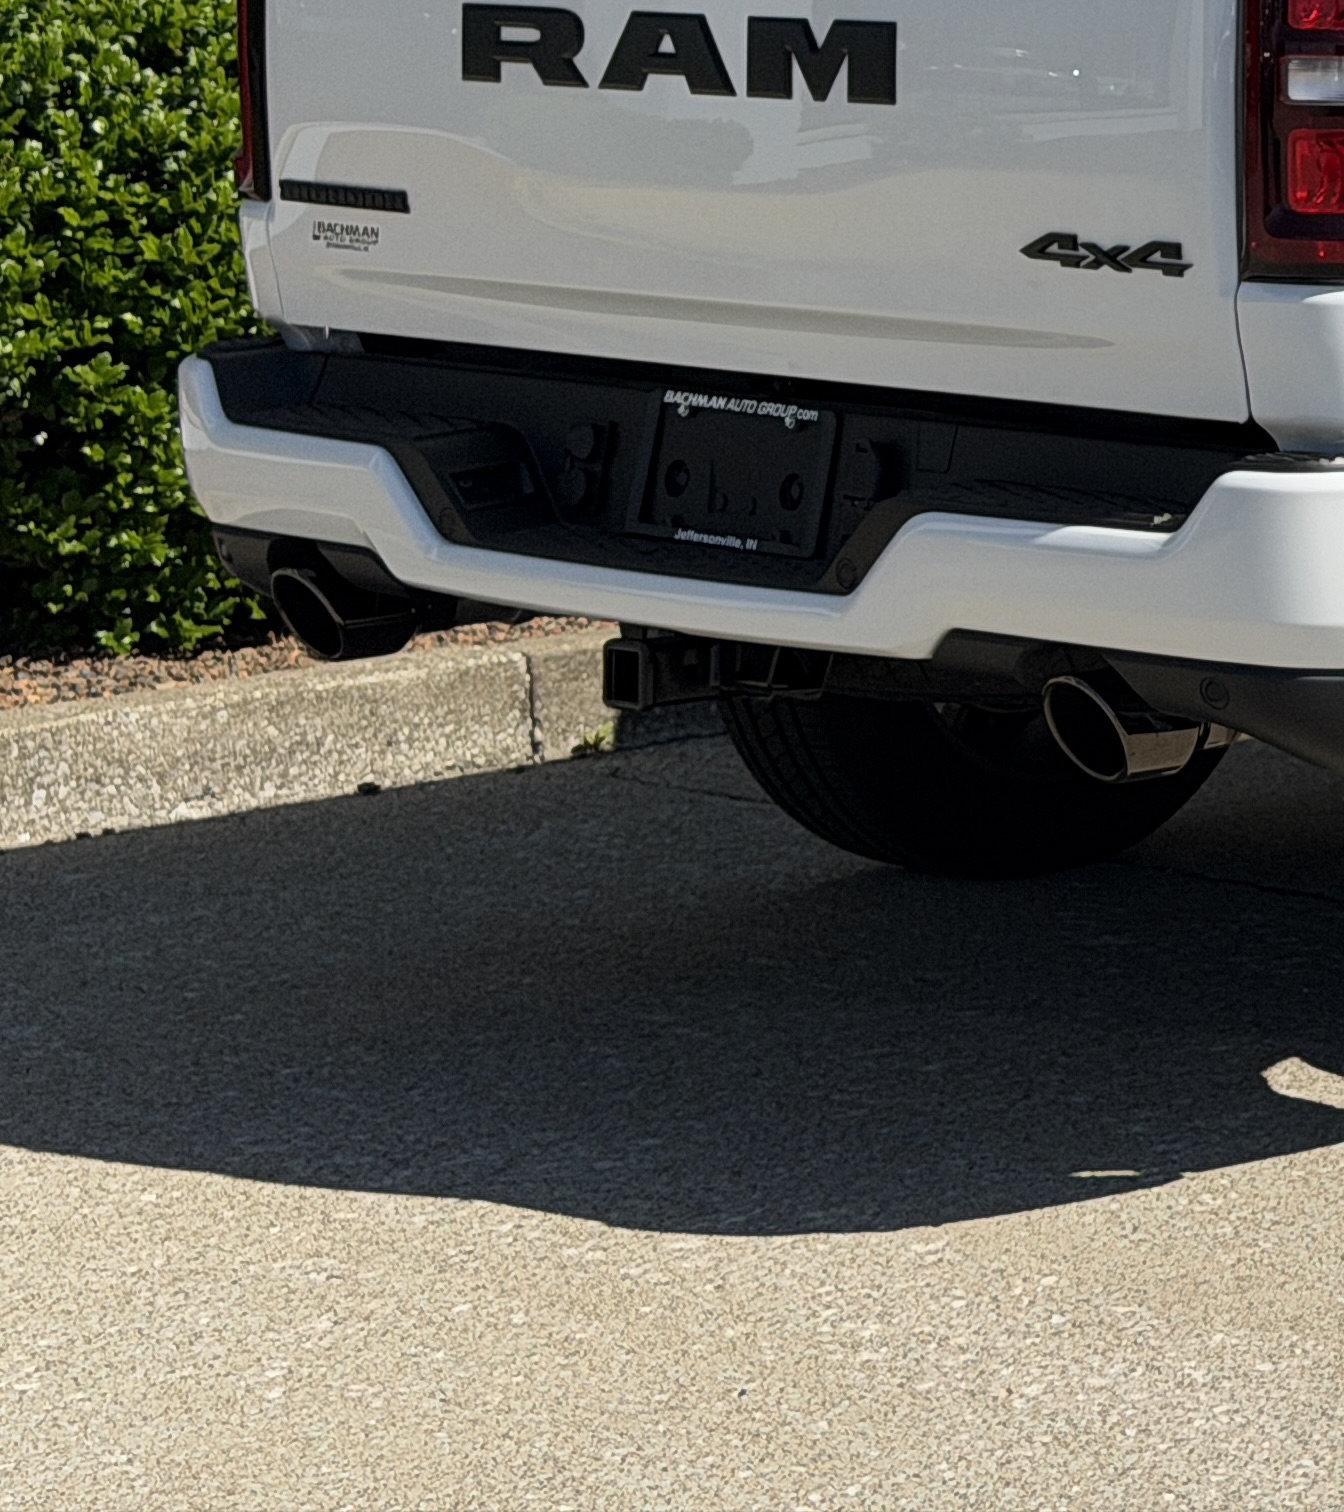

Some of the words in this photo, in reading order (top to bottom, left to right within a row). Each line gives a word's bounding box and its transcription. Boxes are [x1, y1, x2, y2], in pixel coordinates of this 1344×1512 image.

[462, 2, 897, 105] RAM
[317, 221, 379, 238] BACHMAN
[664, 390, 727, 410] BACHMAN
[727, 396, 758, 415] AUTO
